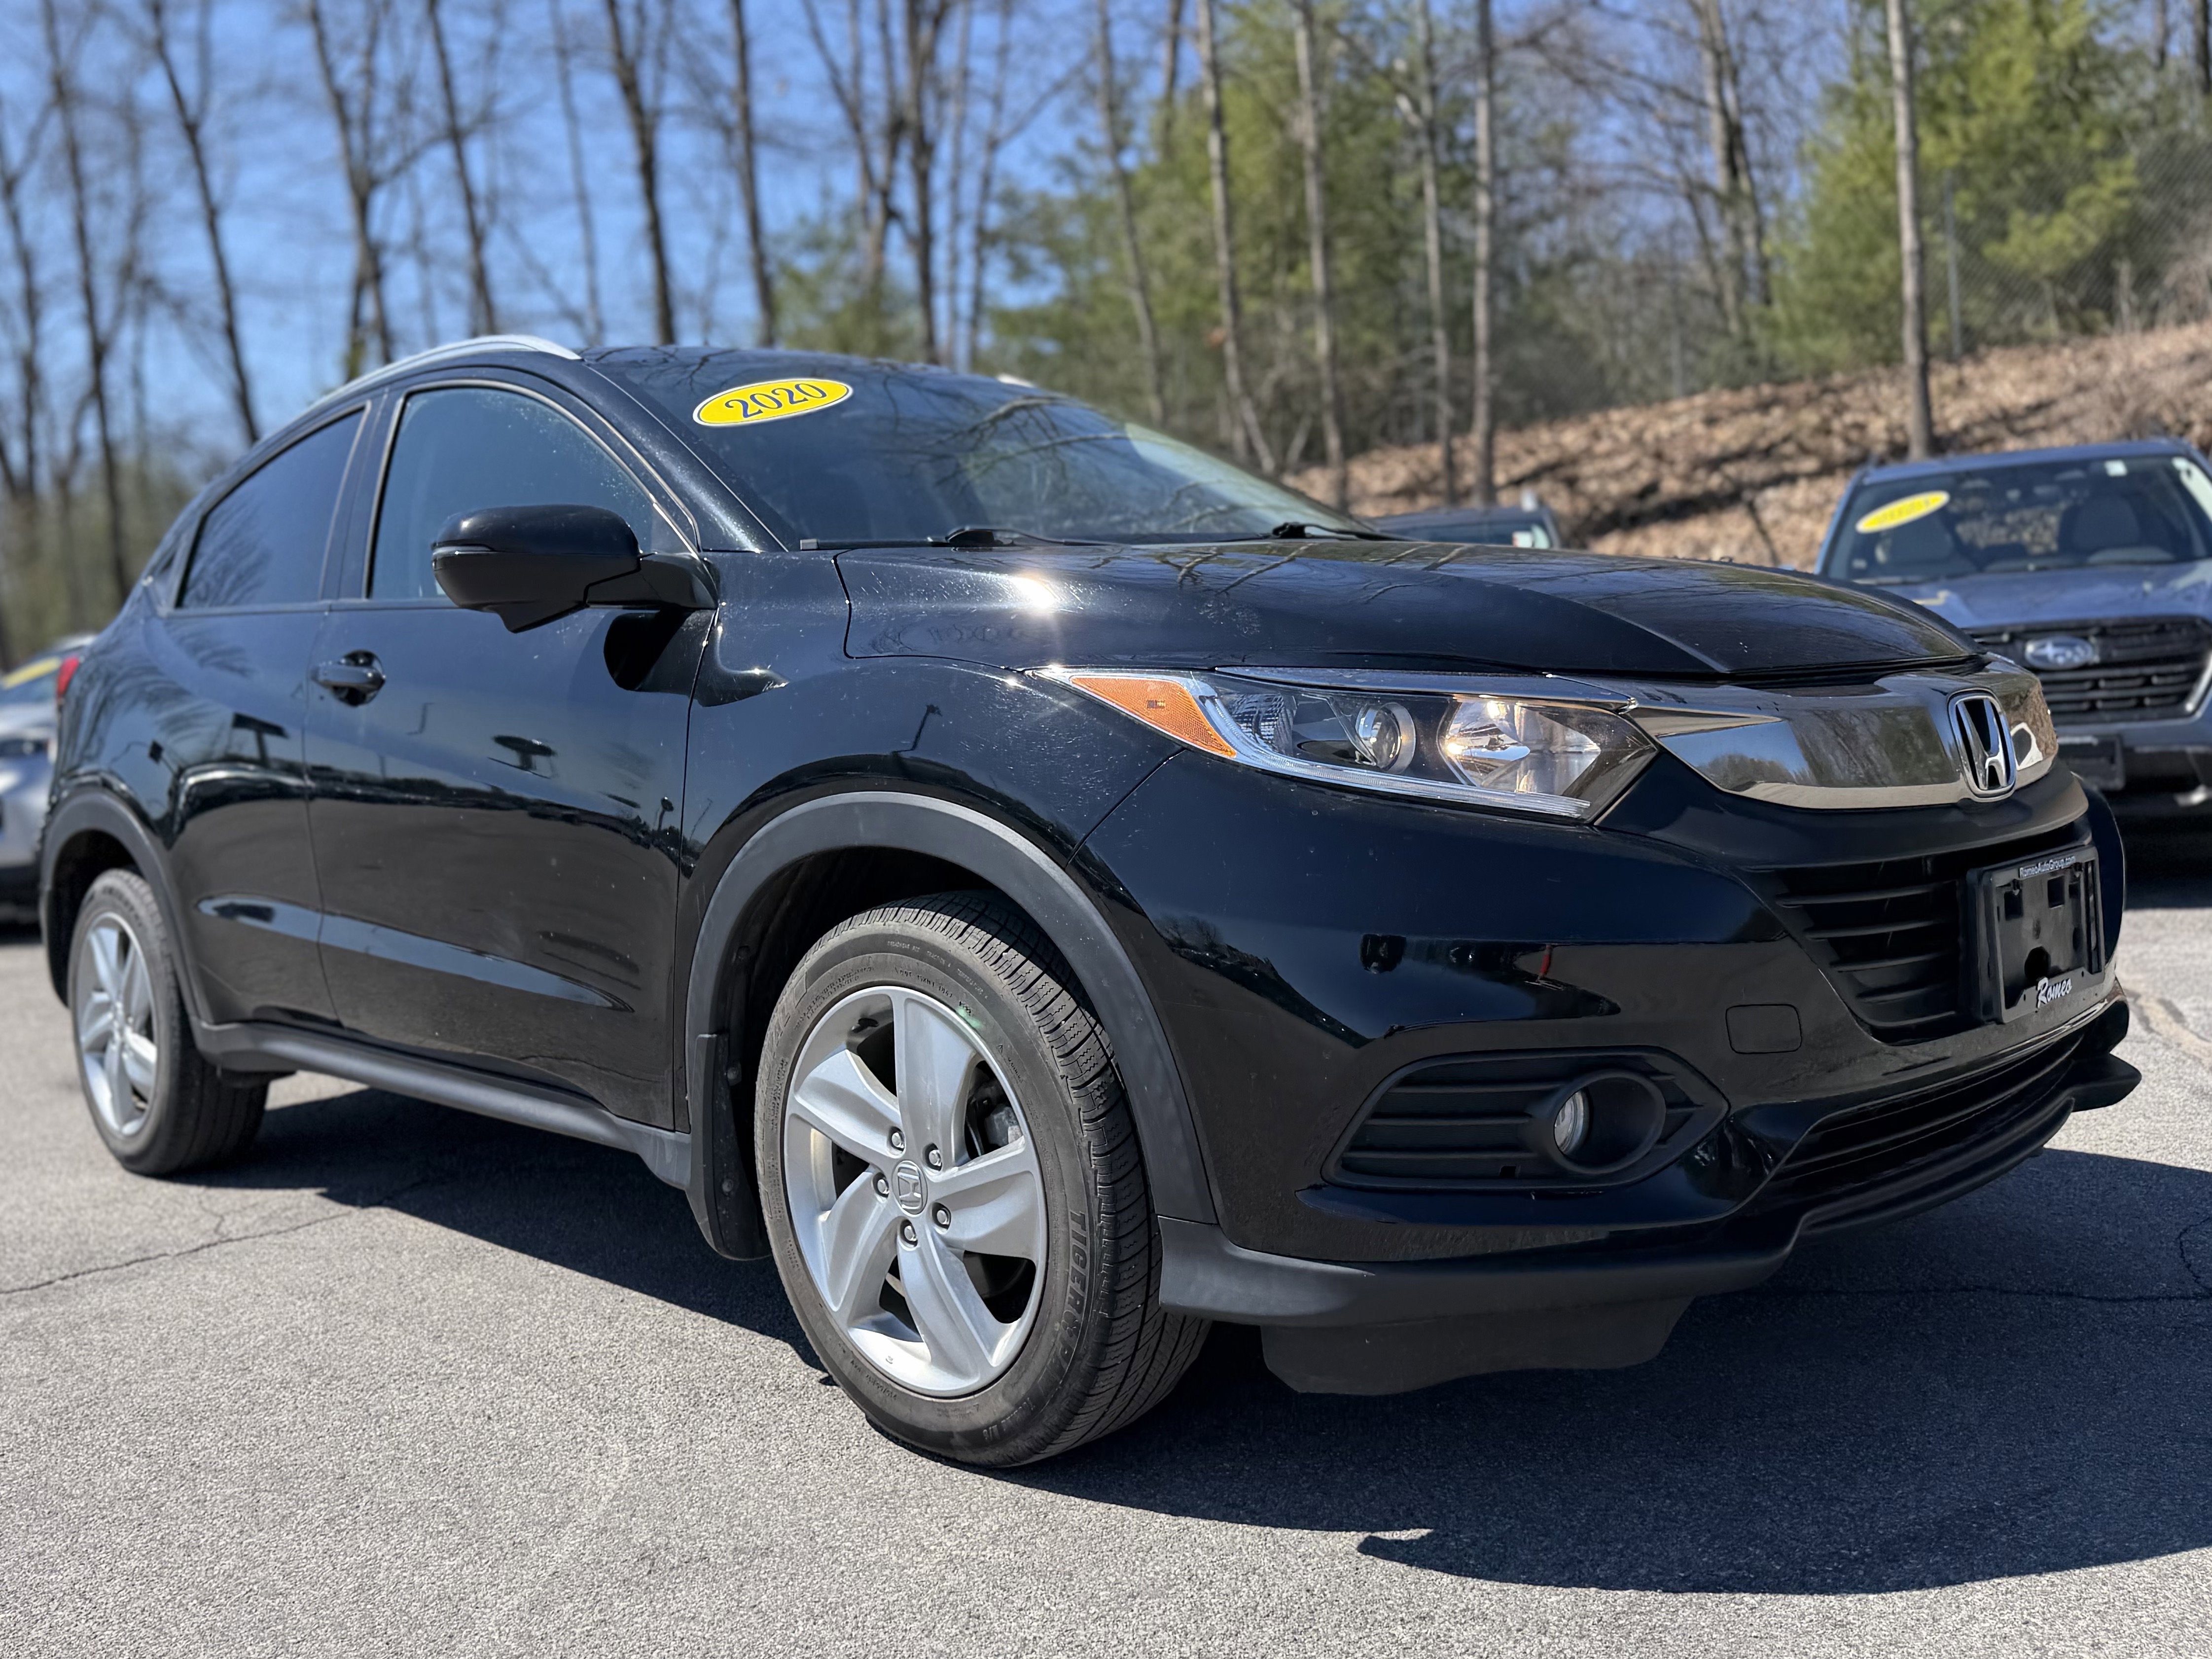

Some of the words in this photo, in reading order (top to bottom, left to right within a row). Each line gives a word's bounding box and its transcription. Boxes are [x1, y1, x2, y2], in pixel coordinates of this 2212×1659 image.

[724, 382, 826, 418] 2020
[2019, 856, 2075, 878] RomeoAutoGroup.com
[2037, 977, 2072, 1009] Romeo
[1067, 1210, 1087, 1315] TIGER
